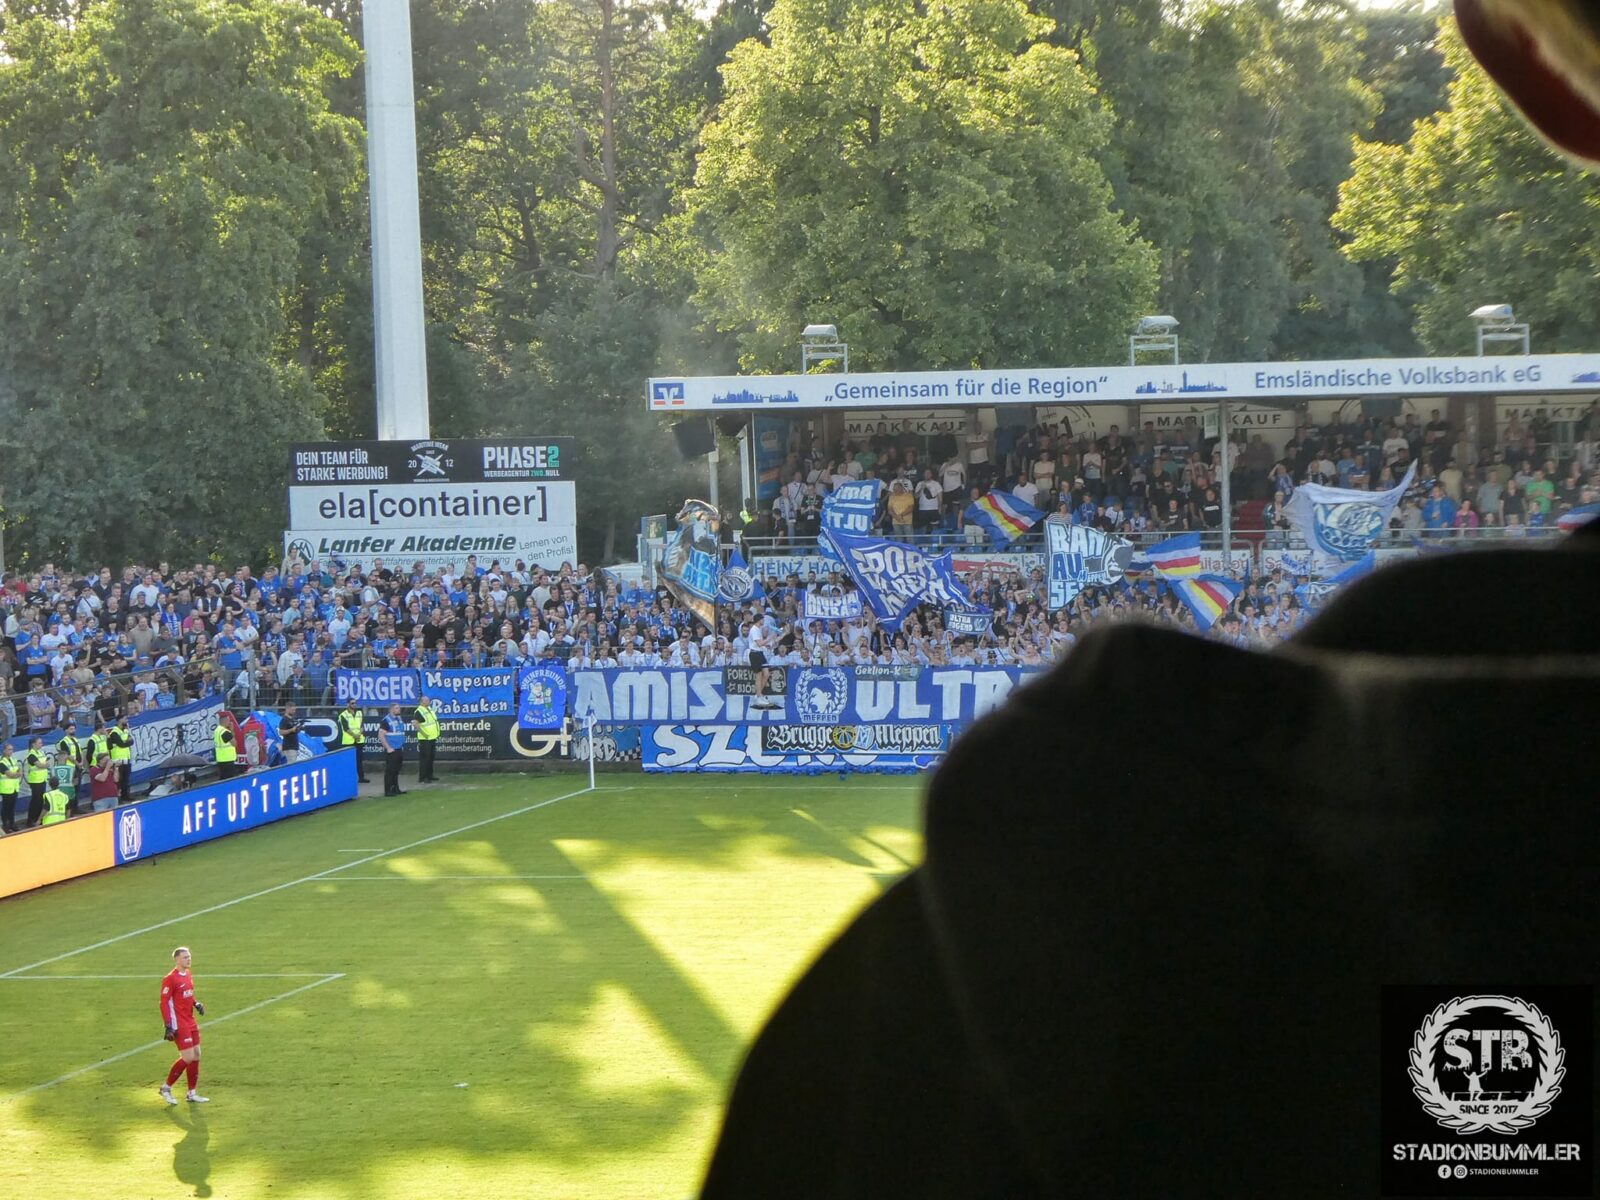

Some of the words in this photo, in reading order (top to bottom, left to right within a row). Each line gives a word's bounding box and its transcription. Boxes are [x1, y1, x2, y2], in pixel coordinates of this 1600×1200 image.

[1255, 368, 1392, 389] Emsländische
[1398, 365, 1506, 386] Volksbank
[1513, 365, 1542, 383] eG
[824, 380, 949, 402] „Gemeinsam
[955, 377, 985, 397] für
[990, 377, 1021, 396] die
[1028, 375, 1108, 399] Region“
[296, 452, 319, 466] DEIN
[320, 450, 347, 465] TEAM
[349, 448, 369, 465] FÜR
[408, 460, 418, 468] 20
[445, 459, 454, 467] 12
[483, 445, 560, 469] PHASE2
[297, 466, 336, 481] STARKE
[336, 465, 389, 480] WERBUNG!
[319, 485, 548, 525] ela[container]
[318, 536, 395, 554] Lanfer
[400, 533, 517, 552] Akademie
[519, 538, 550, 551] Lernen
[551, 535, 568, 545] von
[1050, 522, 1106, 558] BAN
[527, 551, 545, 561] den
[753, 561, 804, 576] HEINZ
[1052, 553, 1083, 581] AU
[336, 670, 416, 700] BÖRGER
[425, 671, 511, 693] Meppener
[430, 698, 508, 715] Rabauken
[855, 670, 1036, 722] ULTR
[523, 713, 558, 725] EMSLAND
[182, 797, 217, 835] AFF
[279, 767, 328, 808] FELT!
